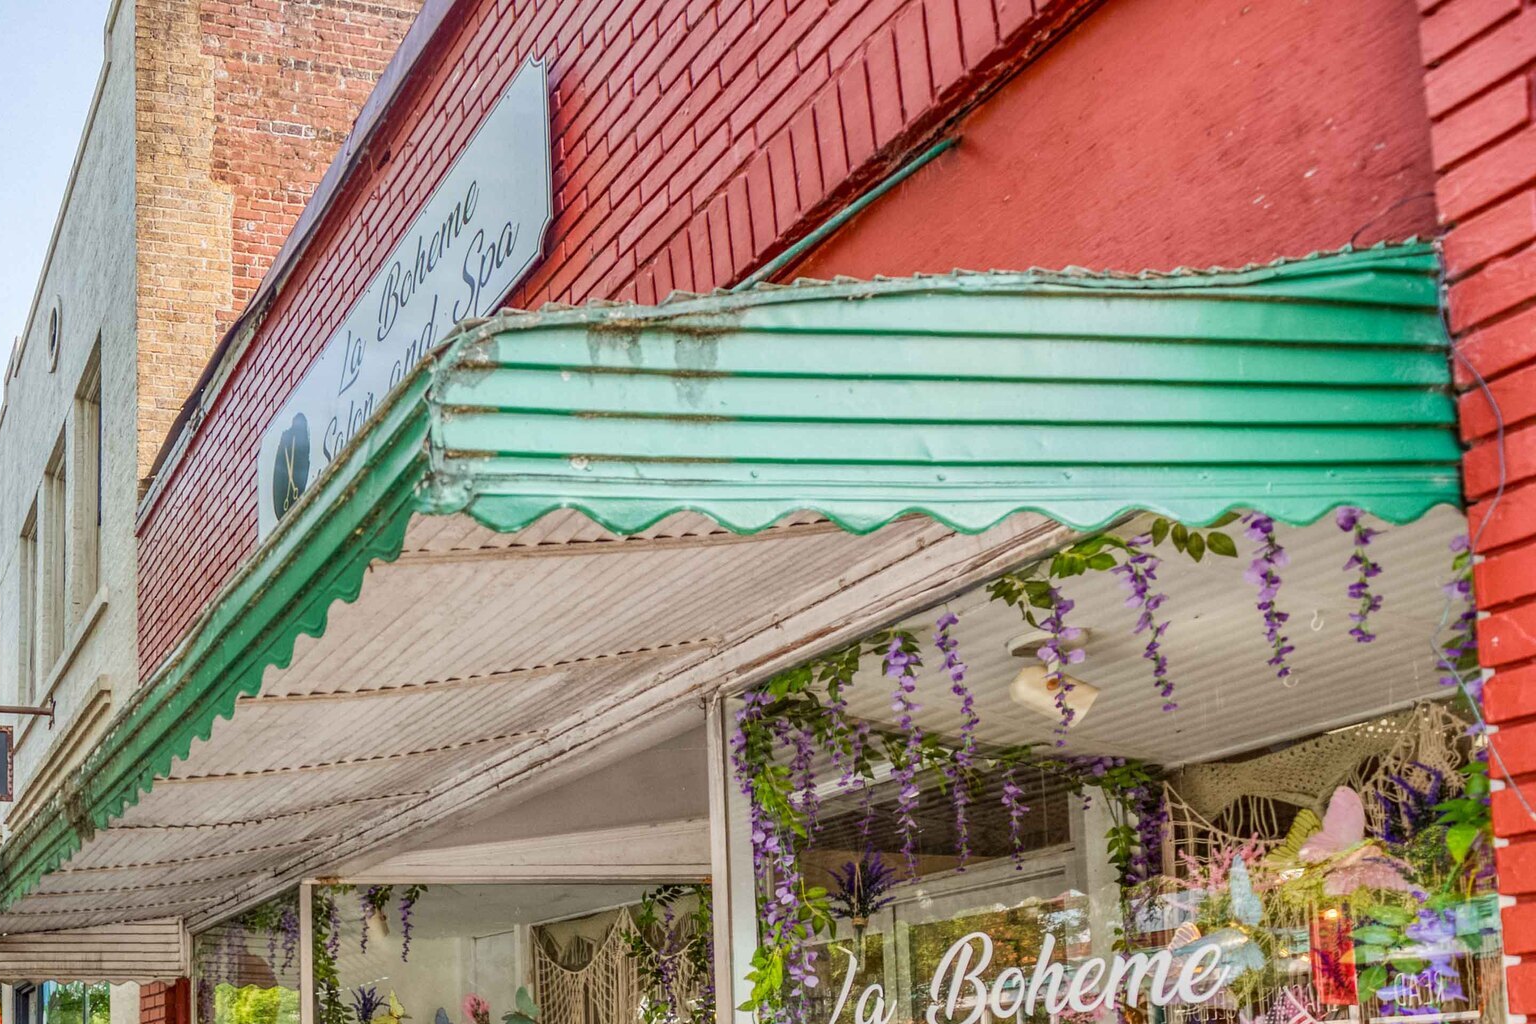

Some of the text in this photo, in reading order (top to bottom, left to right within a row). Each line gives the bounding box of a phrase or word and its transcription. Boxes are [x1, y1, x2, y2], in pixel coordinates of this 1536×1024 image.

[338, 180, 479, 397] La Boheme
[389, 294, 438, 392] and
[452, 221, 520, 325] Spa
